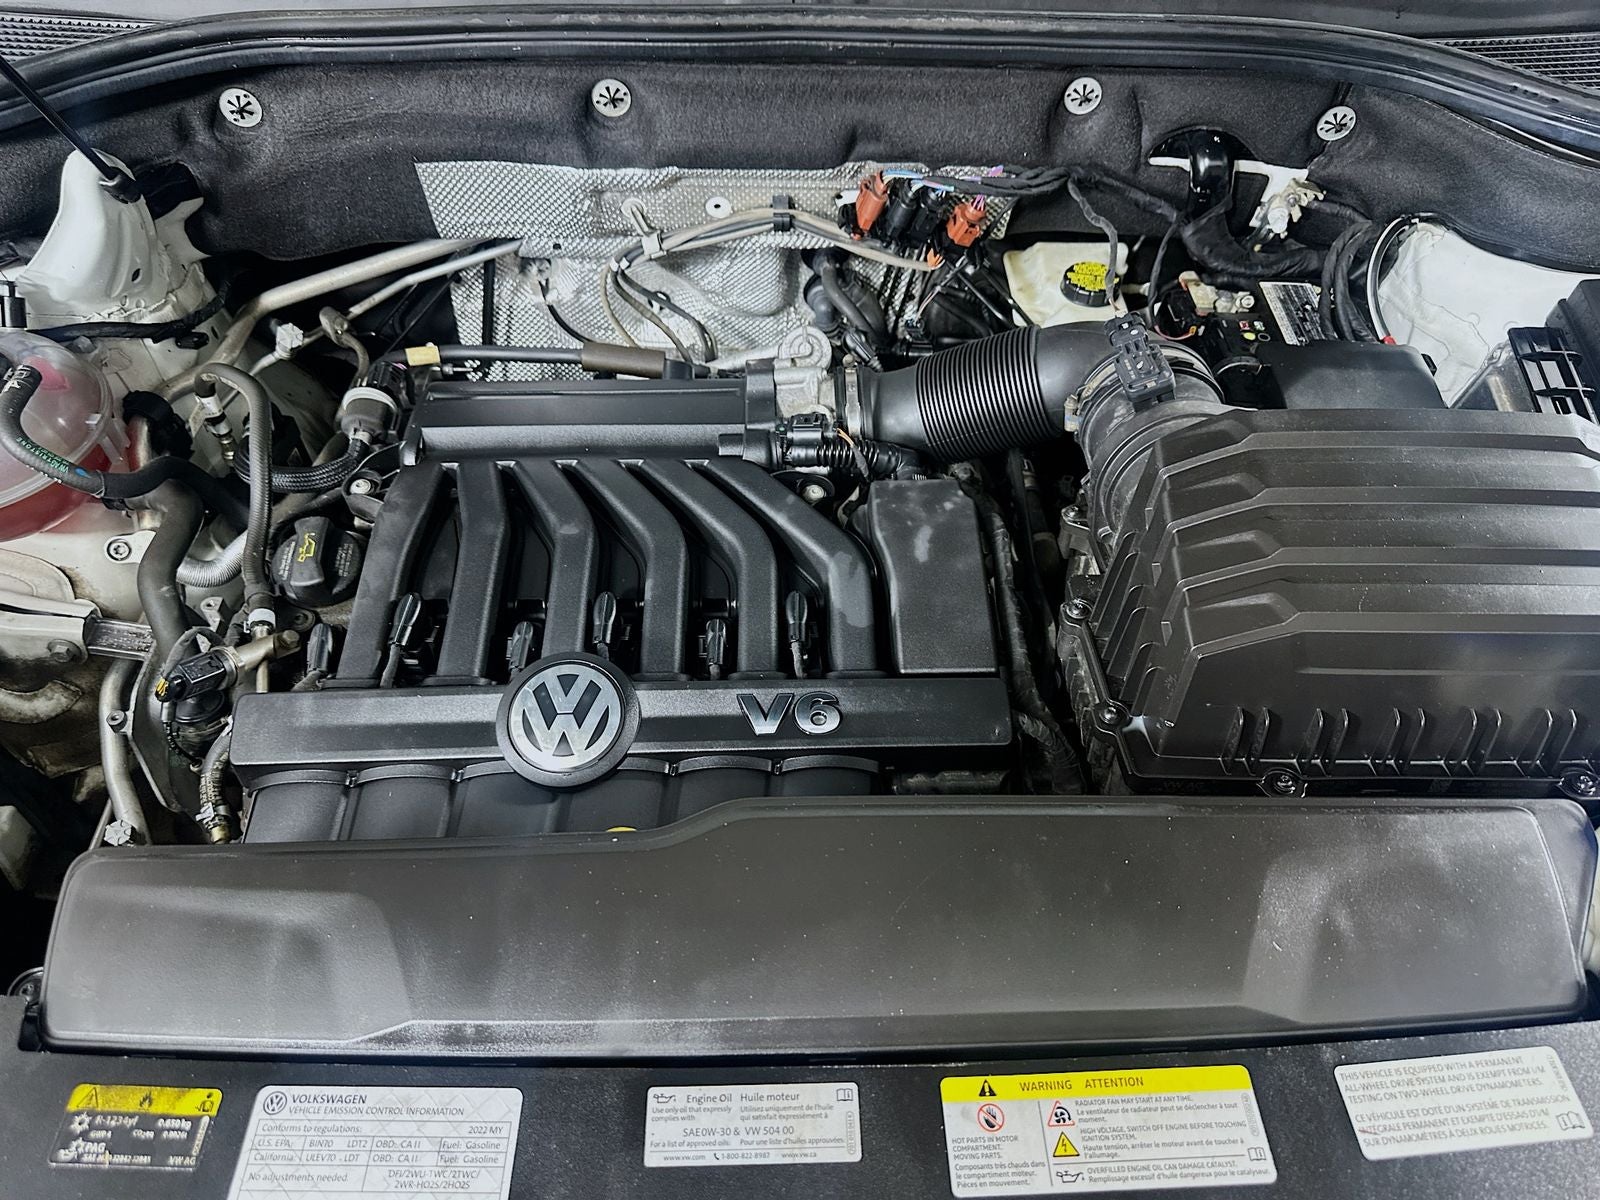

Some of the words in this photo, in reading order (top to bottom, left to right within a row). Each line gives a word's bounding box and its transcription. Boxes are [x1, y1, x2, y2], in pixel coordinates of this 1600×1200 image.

[737, 691, 843, 736] V6
[1340, 1072, 1358, 1080] THIS
[1360, 1068, 1394, 1079] VEHICLE
[1395, 1068, 1402, 1076] IS
[1403, 1063, 1443, 1076] EQUIPPED
[1445, 1062, 1467, 1071] WITH
[1475, 1056, 1522, 1068] PERMANENT
[1020, 1080, 1072, 1092] WARNING
[1085, 1077, 1144, 1089] ATTENTION
[1344, 1081, 1390, 1092] ALL-WHEEL
[1391, 1078, 1415, 1088] DRIVE
[1416, 1075, 1445, 1086] SYSTEM
[1448, 1073, 1466, 1082] AND
[1467, 1072, 1475, 1080] IS
[1476, 1069, 1505, 1079] EXEMPT
[292, 1094, 367, 1104] VOLKSWAGEN
[686, 1093, 717, 1105] Engine
[719, 1093, 732, 1102] Oil
[740, 1092, 764, 1102] Huile
[766, 1093, 800, 1101] moteur
[1348, 1093, 1383, 1104] TESTING
[1384, 1091, 1397, 1100] ON
[1399, 1087, 1449, 1099] TWO-WHEEL
[1450, 1084, 1476, 1094] DRIVE
[289, 1106, 321, 1114] VEHICLE
[324, 1106, 363, 1115] EMISSION
[365, 1106, 404, 1115] CONTROL
[406, 1107, 464, 1116] INFORMATION
[665, 1106, 679, 1114] only
[689, 1105, 702, 1113] that
[703, 1105, 732, 1114] expressly
[765, 1104, 804, 1113] uniquement
[805, 1103, 813, 1111] de
[1086, 1107, 1119, 1115] ventilateur
[1130, 1105, 1158, 1113] radiateur
[740, 1114, 750, 1122] qui
[1355, 1114, 1365, 1123] CE
[1406, 1109, 1420, 1118] EST
[262, 1123, 300, 1132] Conforms
[303, 1124, 312, 1132] to
[314, 1124, 362, 1134] regulations:
[468, 1126, 488, 1134] 2022
[489, 1126, 504, 1134] MY
[733, 1126, 741, 1136] &
[744, 1126, 760, 1135] VW
[763, 1126, 780, 1135] 504
[782, 1125, 794, 1135] 00
[1127, 1125, 1151, 1133] SWITCH
[1190, 1122, 1214, 1130] BEFORE
[1214, 1121, 1247, 1129] TOUCHING
[740, 1138, 754, 1146] Pour
[1081, 1134, 1110, 1142] IGNITION
[1205, 1138, 1213, 1146] de
[309, 1139, 333, 1148] BIN70
[347, 1139, 367, 1148] LDT2
[375, 1140, 397, 1149] OBD:
[442, 1141, 461, 1149] Fuel:
[465, 1140, 501, 1150] Gasoline
[650, 1140, 660, 1148] For
[686, 1139, 717, 1148] approved
[344, 1153, 360, 1162] LDT
[440, 1155, 459, 1163] Fuel:
[463, 1154, 499, 1164] Gasoline
[953, 1152, 980, 1160] MOVING
[954, 1163, 993, 1172] Composants
[1007, 1160, 1030, 1168] chauds
[1030, 1160, 1046, 1168] dans
[1127, 1164, 1151, 1172] ENGINE
[248, 1172, 259, 1181] No
[263, 1172, 314, 1183] adjustments
[963, 1170, 1010, 1180] compartiment
